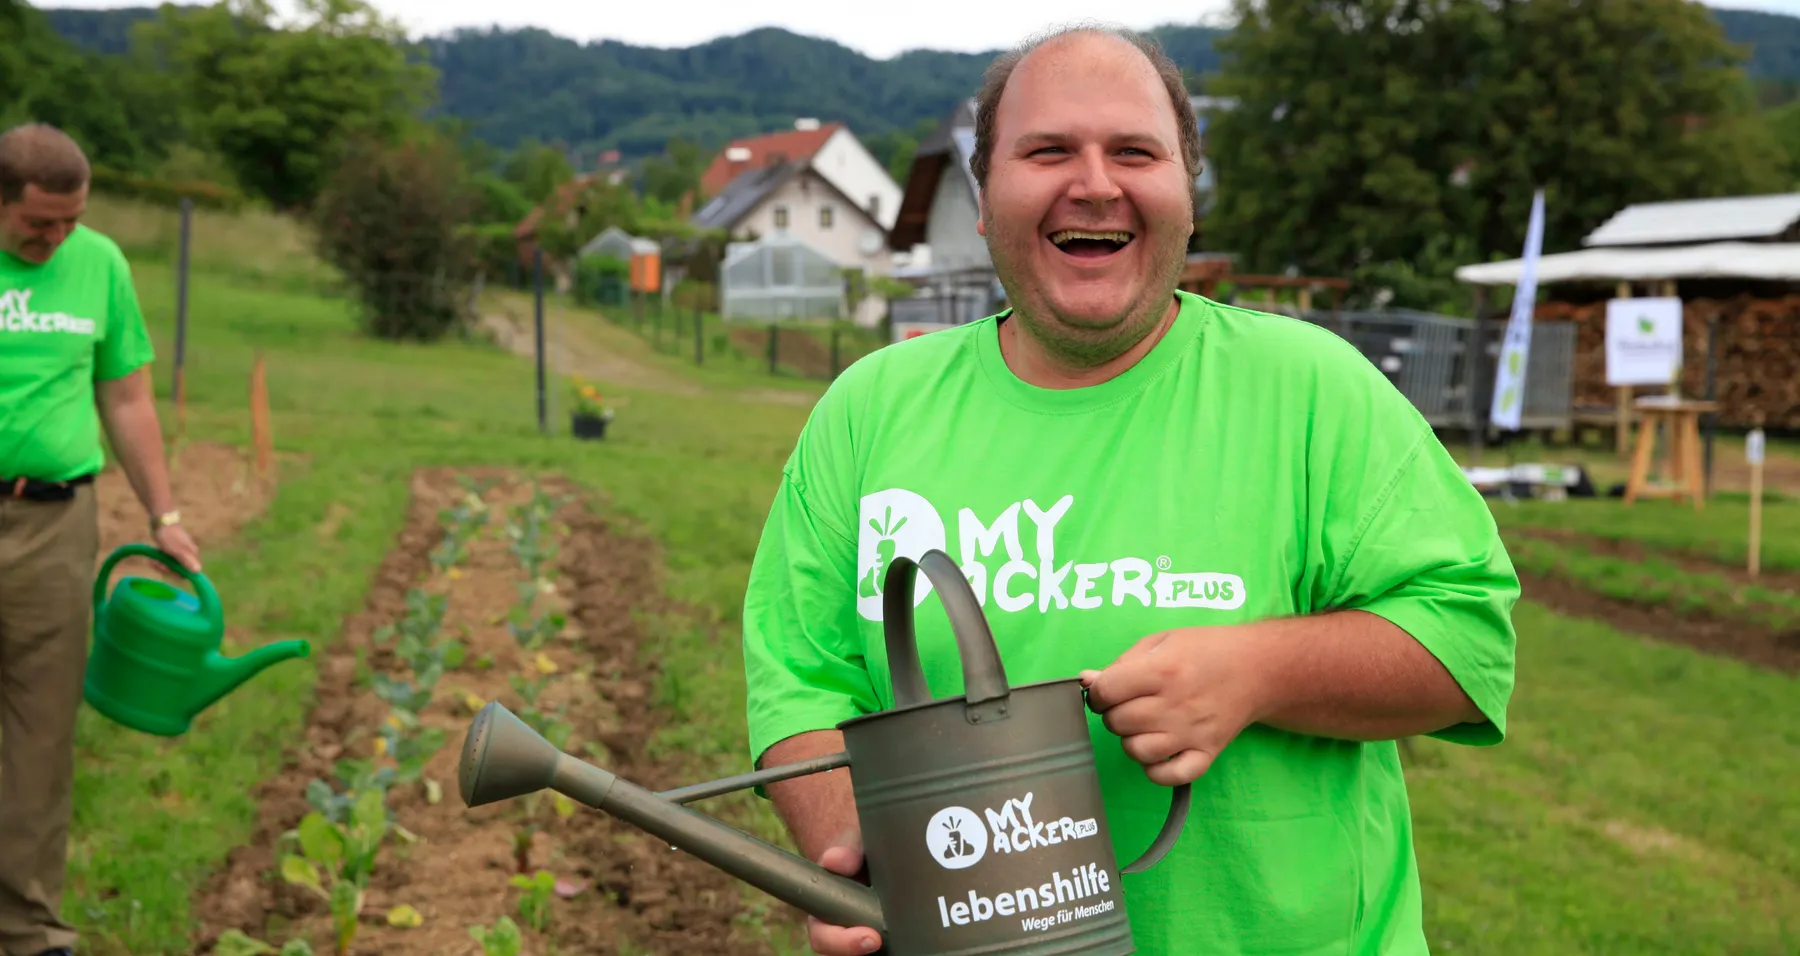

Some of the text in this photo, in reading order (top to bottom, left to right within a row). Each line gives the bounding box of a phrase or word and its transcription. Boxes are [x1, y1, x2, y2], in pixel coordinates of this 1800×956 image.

[958, 494, 1074, 565] MY
[984, 791, 1034, 834] MY
[993, 817, 1077, 853] ACKER
[937, 862, 1110, 928] lebenshilfe
[1021, 900, 1114, 932] Wege für Menschen
